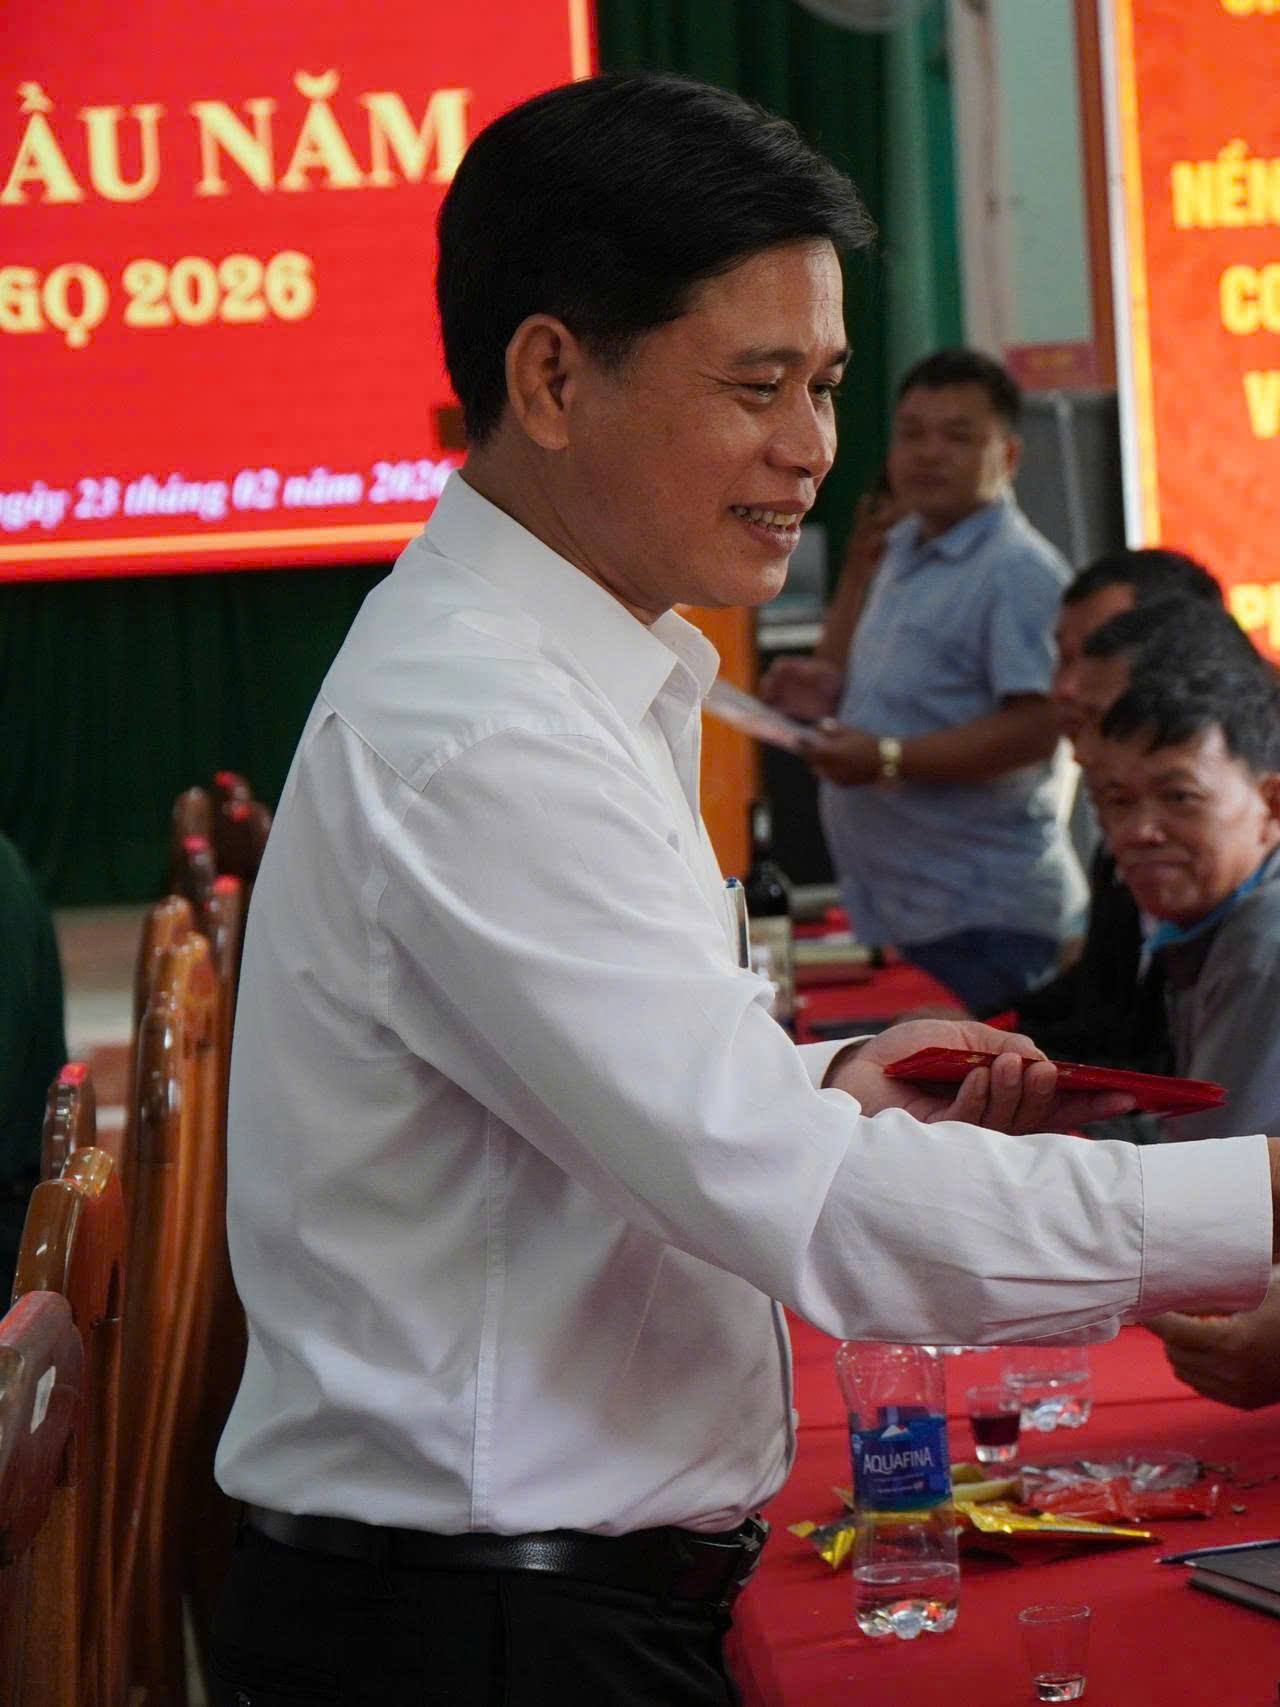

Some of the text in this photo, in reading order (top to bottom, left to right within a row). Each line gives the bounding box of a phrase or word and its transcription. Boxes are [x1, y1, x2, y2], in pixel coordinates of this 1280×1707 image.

[190, 68, 471, 195] NĂM
[122, 250, 316, 328] 2026
[74, 475, 120, 519] 23
[123, 473, 227, 521] tháng
[232, 467, 279, 509] 02
[283, 467, 363, 506] năm
[863, 1447, 935, 1475] AQUAFINA
